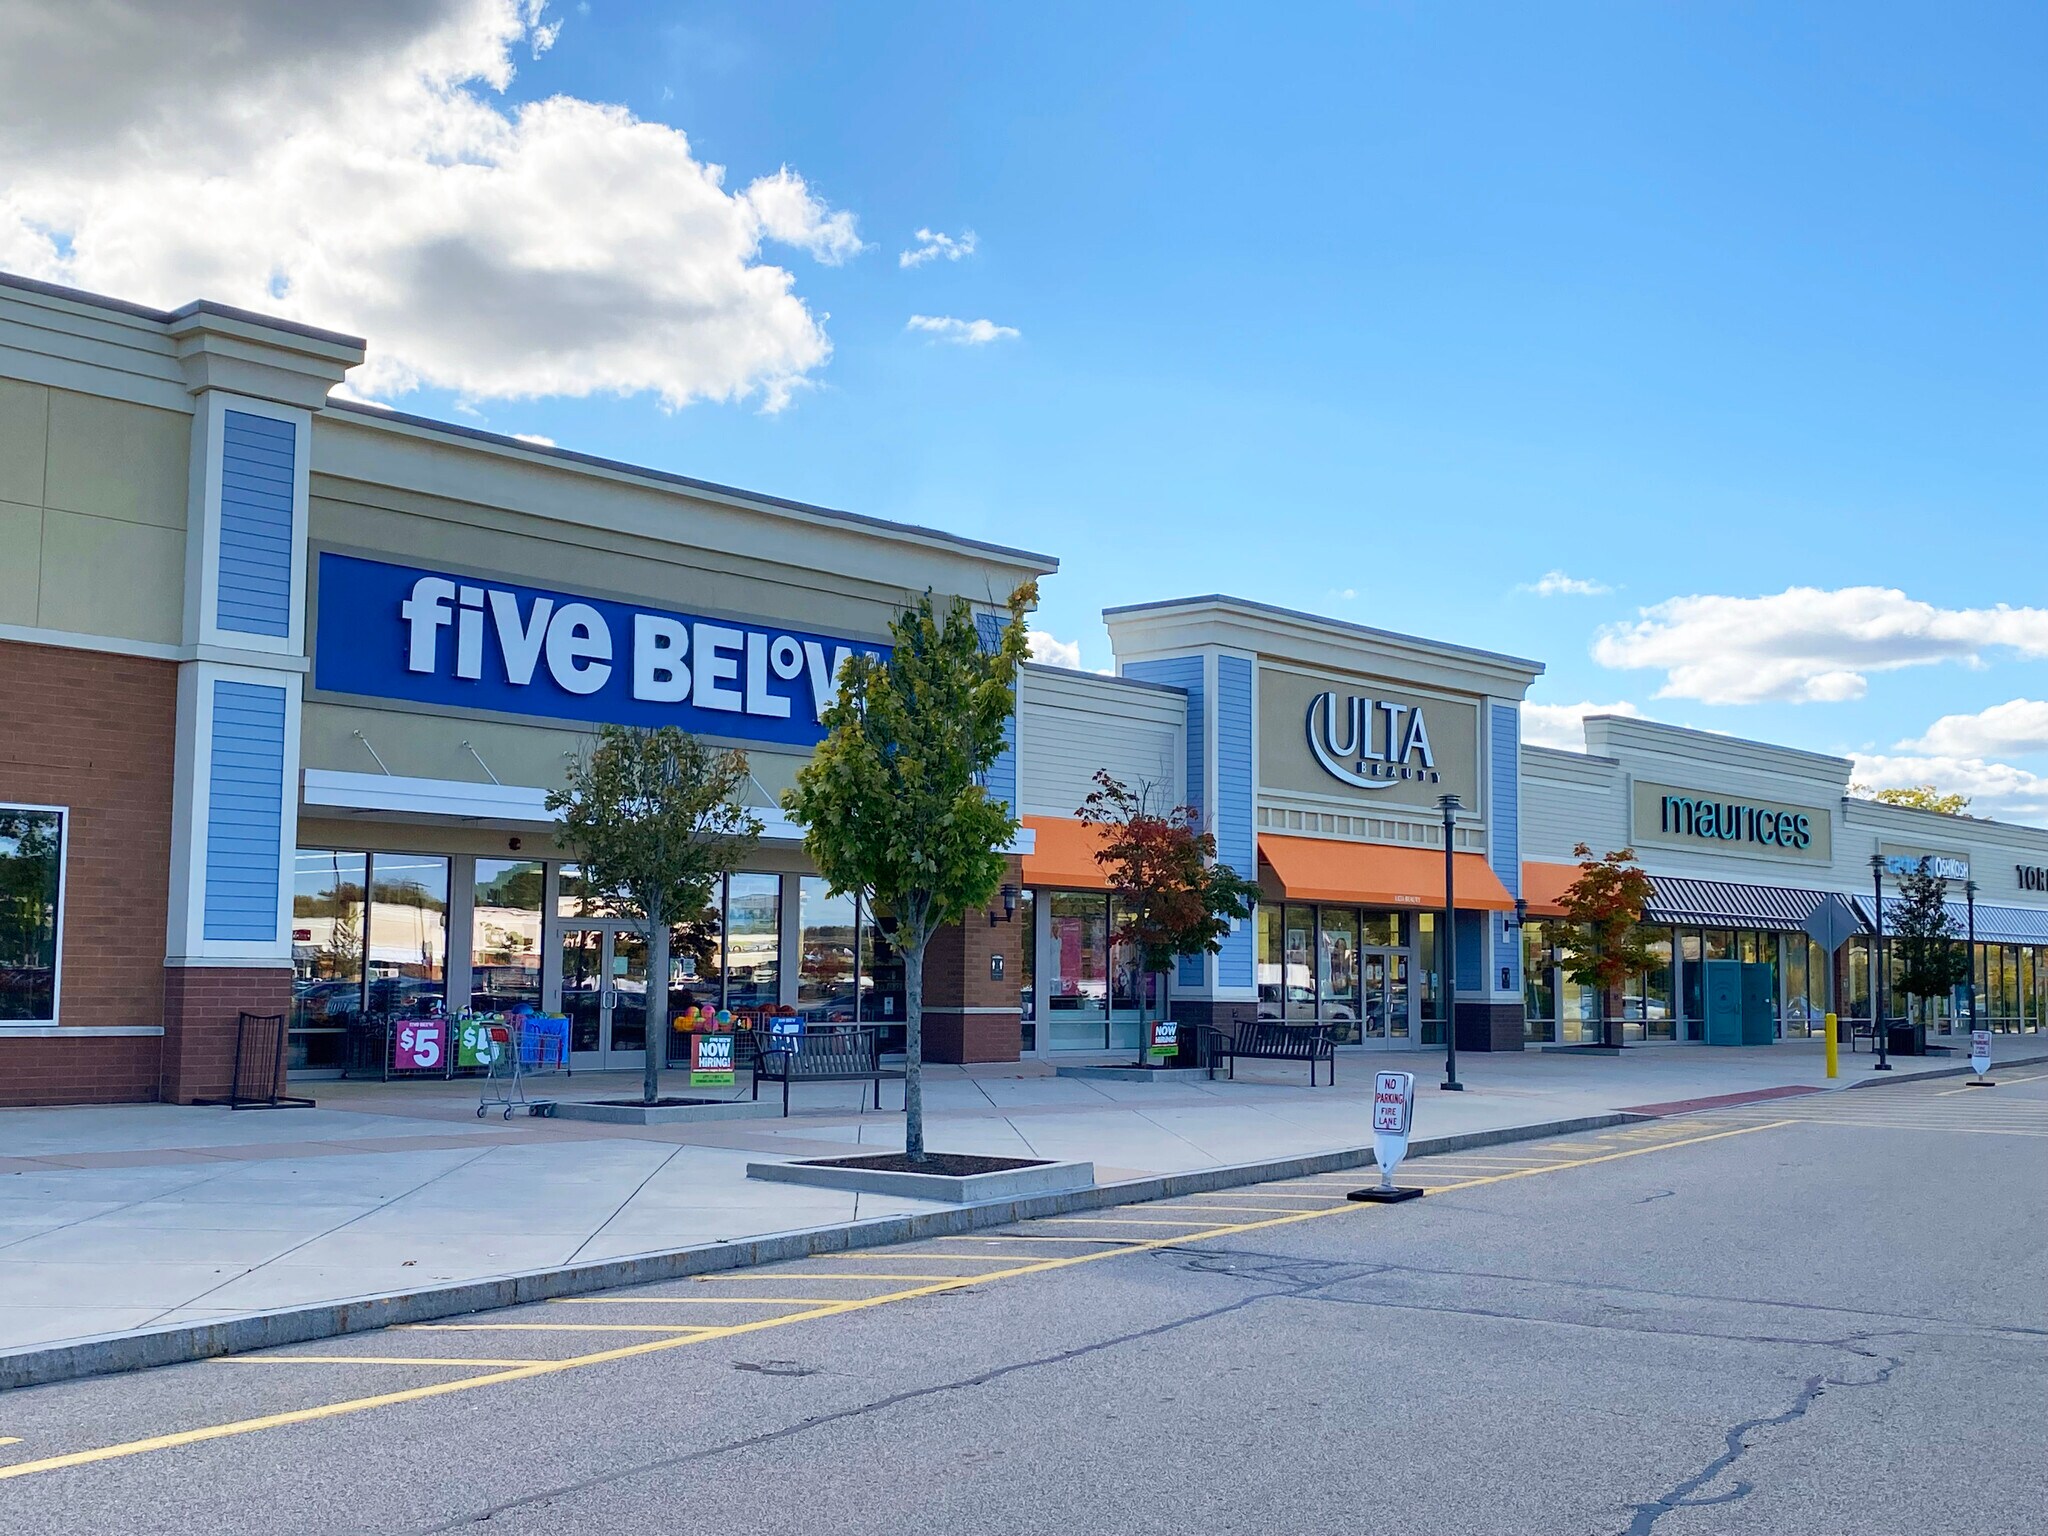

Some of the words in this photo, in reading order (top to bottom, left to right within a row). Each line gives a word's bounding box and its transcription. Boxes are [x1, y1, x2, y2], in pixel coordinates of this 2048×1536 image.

[1322, 691, 1435, 768] ULTA
[1357, 761, 1442, 784] BEAUTY
[1661, 795, 1812, 850] maurices
[2015, 864, 2048, 892] TOR
[1155, 1025, 1177, 1036] NOW
[400, 1028, 440, 1067] $5
[463, 1027, 500, 1065] $5
[699, 1042, 730, 1057] NOW
[1384, 1078, 1397, 1090] NO
[1376, 1092, 1404, 1104] PARKING
[1378, 1116, 1397, 1126] LANE
[1381, 1107, 1397, 1116] FIRE
